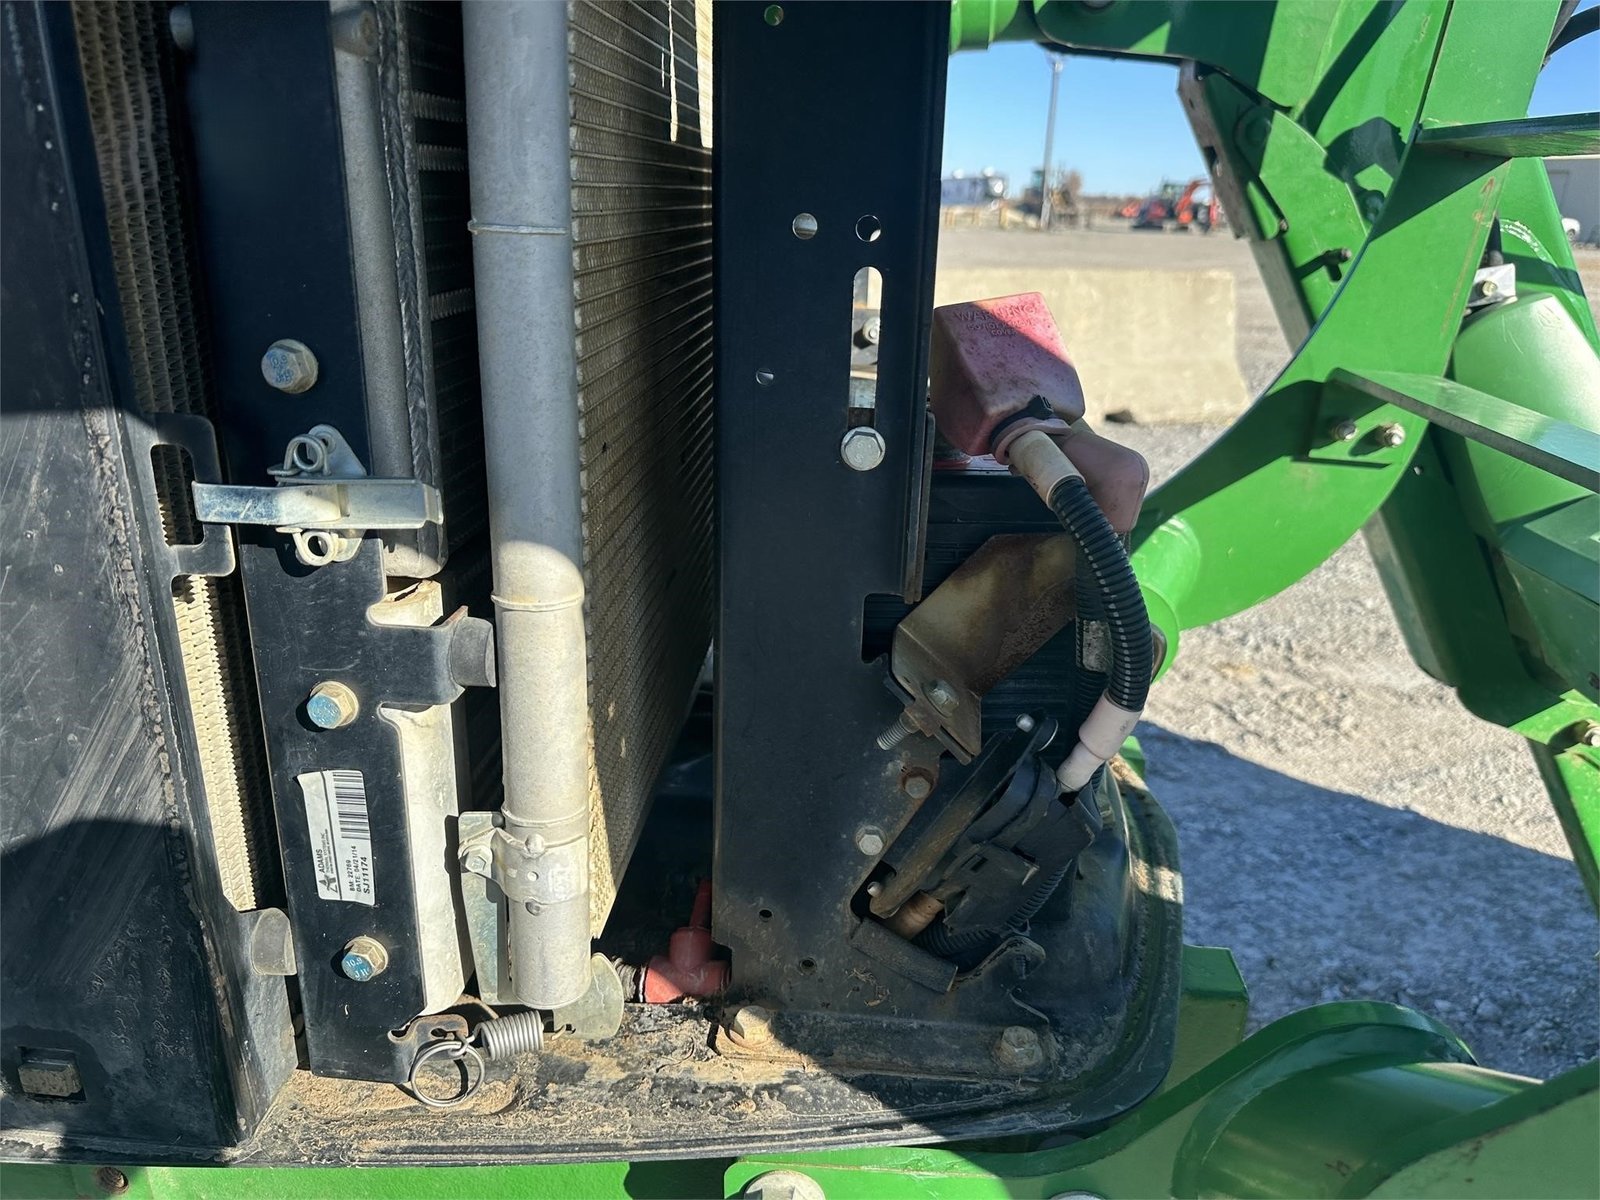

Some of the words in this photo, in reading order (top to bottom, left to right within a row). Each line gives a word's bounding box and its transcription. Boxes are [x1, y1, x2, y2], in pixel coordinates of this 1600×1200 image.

[955, 304, 1035, 321] WARNING
[316, 848, 325, 873] ADAMS
[351, 845, 360, 873] 04/21/14
[360, 856, 370, 894] SJ11174
[346, 957, 363, 967] 10.9
